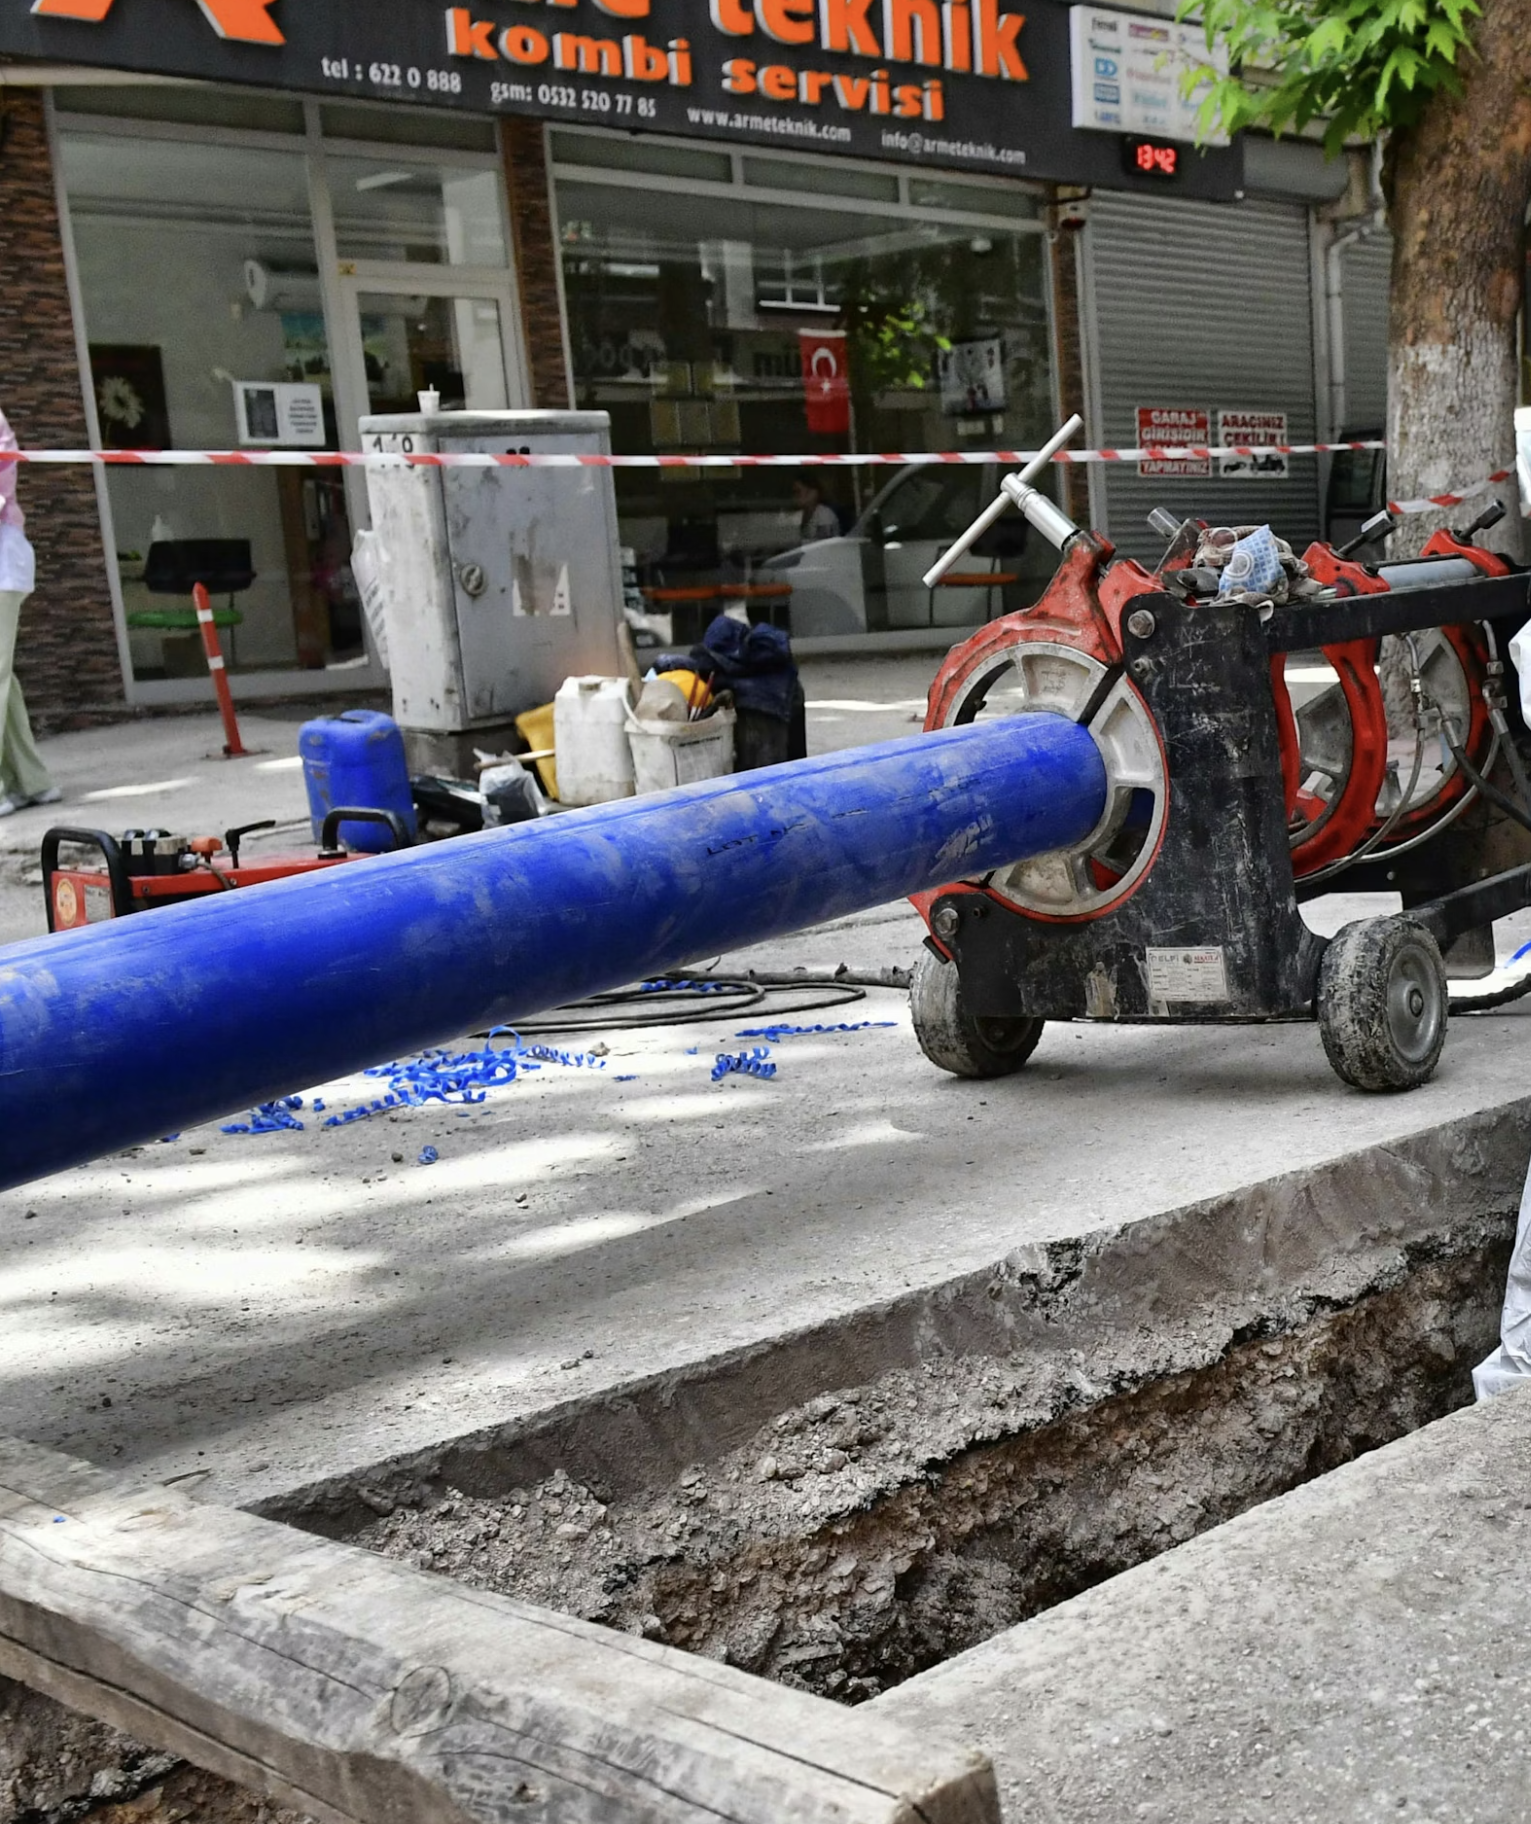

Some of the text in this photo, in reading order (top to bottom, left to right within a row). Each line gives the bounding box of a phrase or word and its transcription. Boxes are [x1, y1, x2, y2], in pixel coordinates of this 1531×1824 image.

[321, 56, 349, 79] tel
[368, 62, 401, 86] 622
[407, 66, 421, 88] 0
[427, 69, 462, 94] 888
[490, 81, 532, 104] gsm:
[537, 84, 577, 108] 0532
[581, 89, 611, 112] 520
[615, 93, 632, 114] 77
[637, 97, 656, 118] 85
[686, 107, 852, 142] www.armeteknik.com
[881, 128, 1027, 165] info@armeteknik.com
[445, 7, 945, 121] kombi servisi
[1151, 410, 1197, 425] GARAJ
